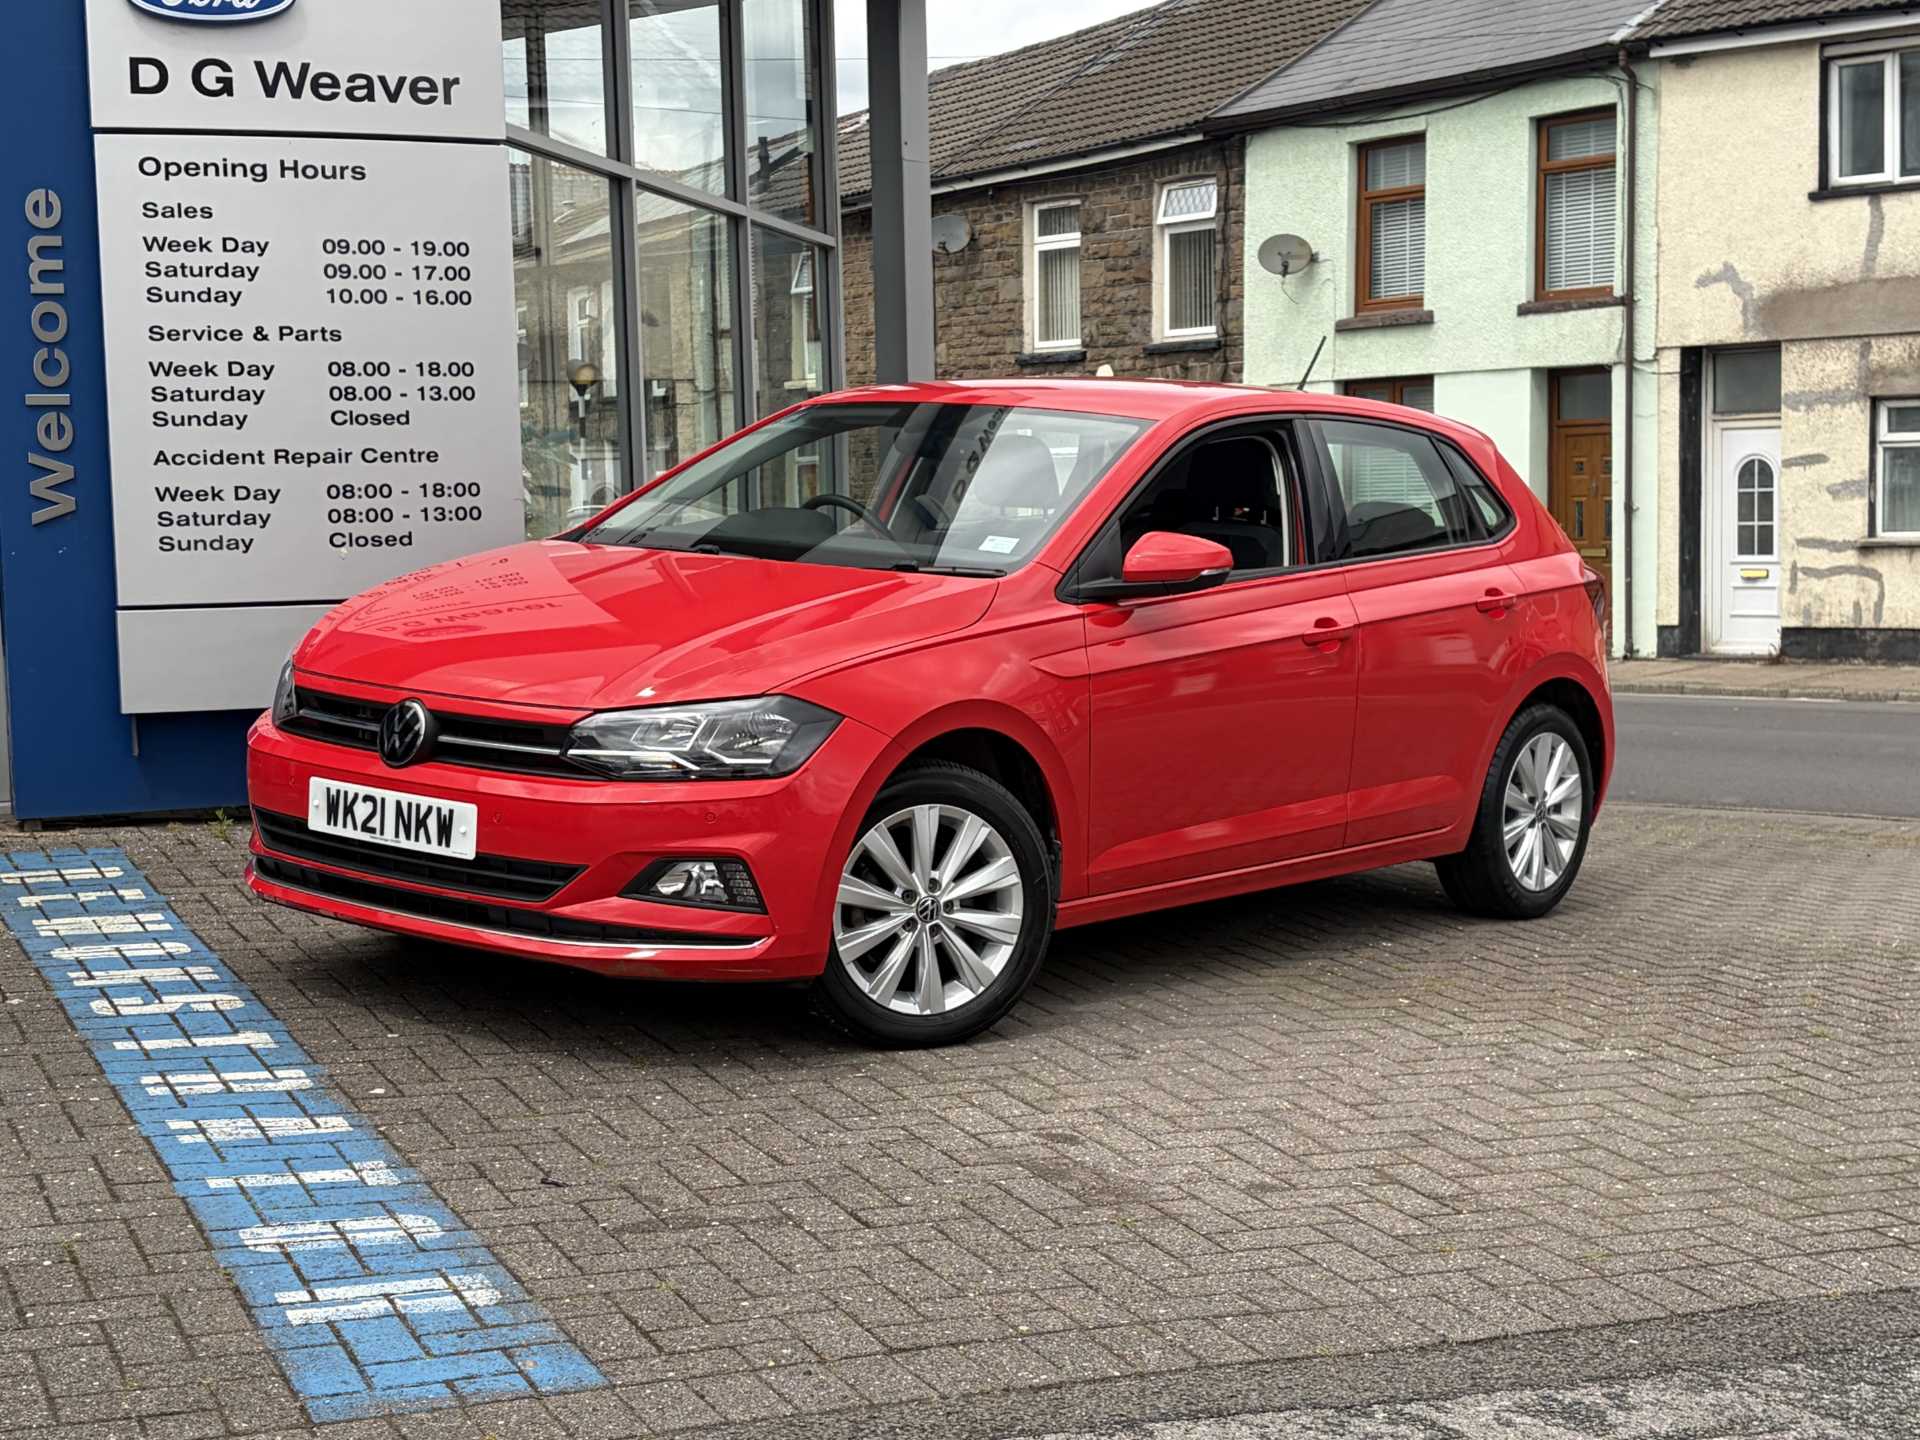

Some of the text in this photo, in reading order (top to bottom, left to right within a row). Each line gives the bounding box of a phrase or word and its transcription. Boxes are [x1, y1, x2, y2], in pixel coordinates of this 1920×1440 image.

[128, 56, 460, 106] D G Weaver
[138, 156, 367, 183] Opening Hours
[142, 201, 214, 220] Sales
[142, 236, 213, 253] Week
[221, 236, 270, 257] Day
[322, 238, 386, 256] 09.00
[410, 240, 470, 258] 19.00
[145, 261, 260, 283] Saturday
[323, 263, 387, 281] 09.00
[411, 265, 471, 282] 17.00
[146, 286, 243, 307] Sunday
[326, 288, 388, 305] 10.00
[412, 289, 472, 306] 16.00
[148, 324, 342, 343] Service & Parts
[24, 188, 77, 526] Welcome
[148, 360, 219, 378] Week
[227, 360, 275, 381] Day
[327, 361, 391, 378] 08.00
[415, 361, 475, 378] 18.00
[151, 385, 266, 406] Saturday
[328, 385, 392, 402] 08.00
[416, 385, 476, 402] 13.00
[152, 409, 410, 431] Sunday Closed
[153, 447, 440, 468] Accident Repair Centre
[154, 485, 225, 503] Week
[233, 485, 281, 505] Day
[326, 482, 393, 500] 08:00
[418, 481, 481, 499] 18:00
[157, 509, 272, 529] Saturday
[327, 506, 394, 524] 08:00
[420, 505, 483, 523] 13:00
[158, 530, 413, 554] Sunday Closed
[326, 786, 455, 849] WK21 NKW
